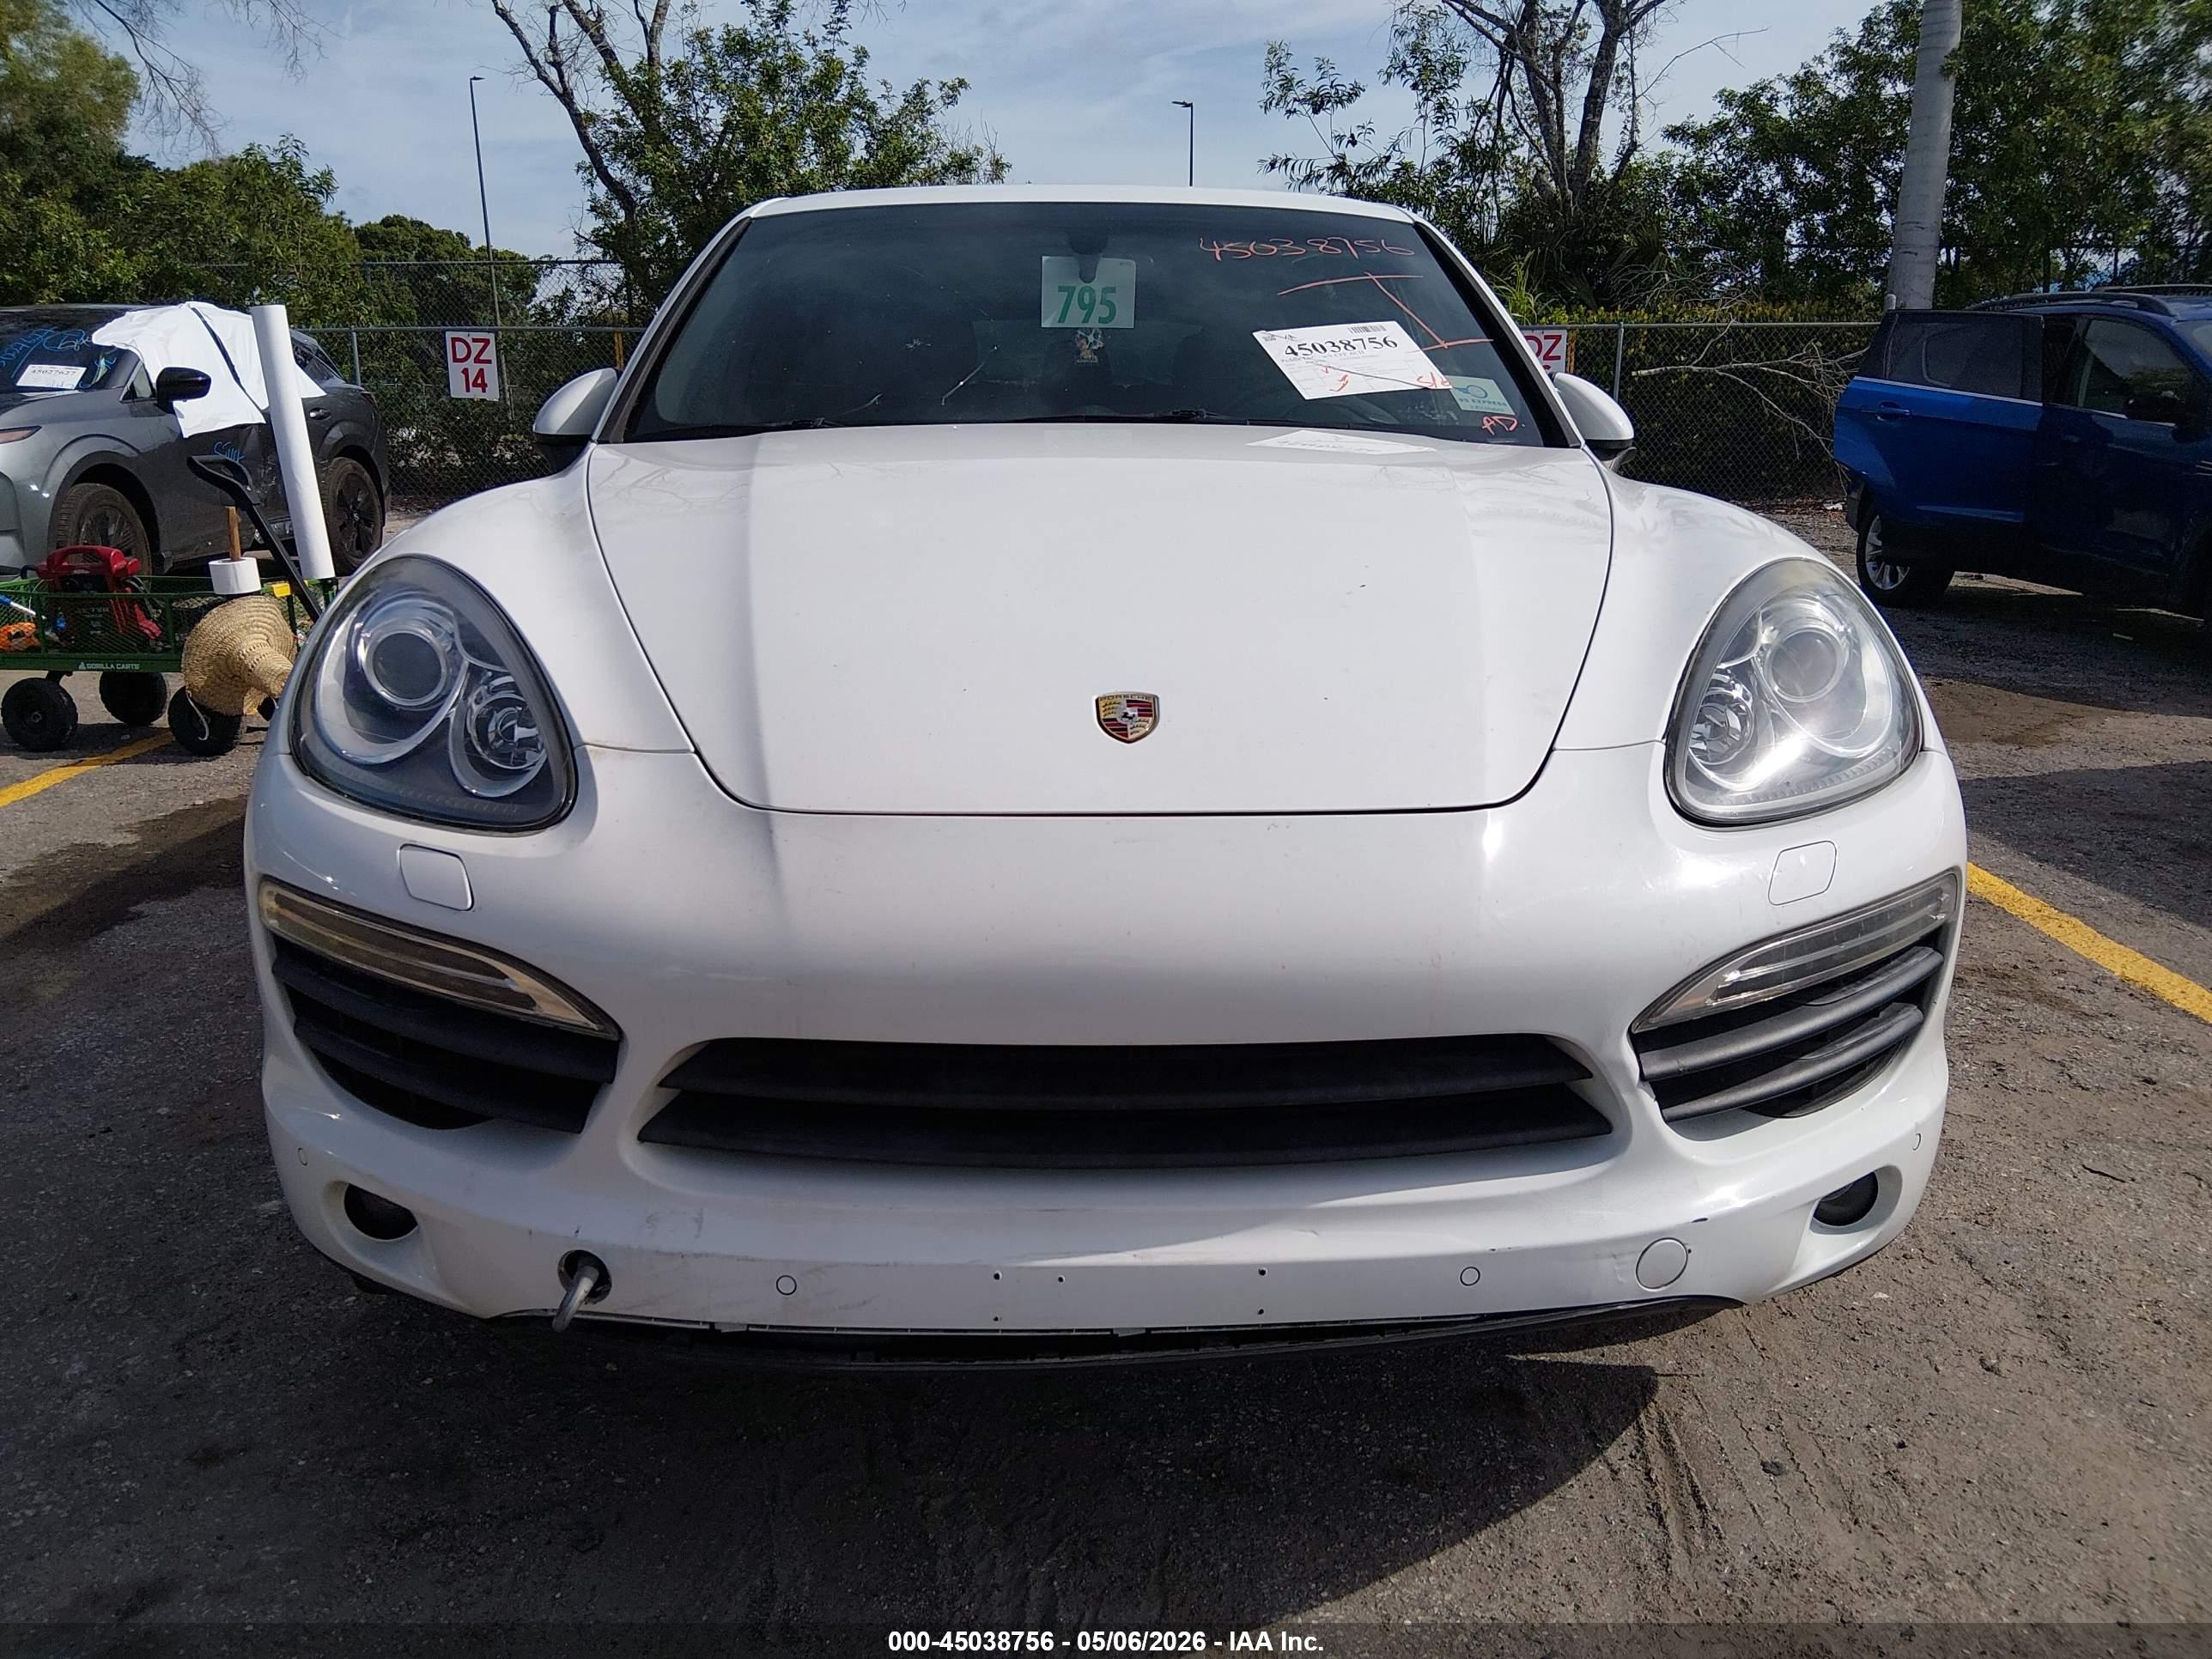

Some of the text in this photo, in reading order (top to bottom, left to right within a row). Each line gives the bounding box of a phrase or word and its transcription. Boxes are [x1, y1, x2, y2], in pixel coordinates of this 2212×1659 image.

[1200, 237, 1415, 261] 45038756
[1057, 285, 1116, 325] 795
[450, 337, 493, 364] DZ
[1284, 336, 1399, 358] 45038756
[460, 368, 489, 393] 14
